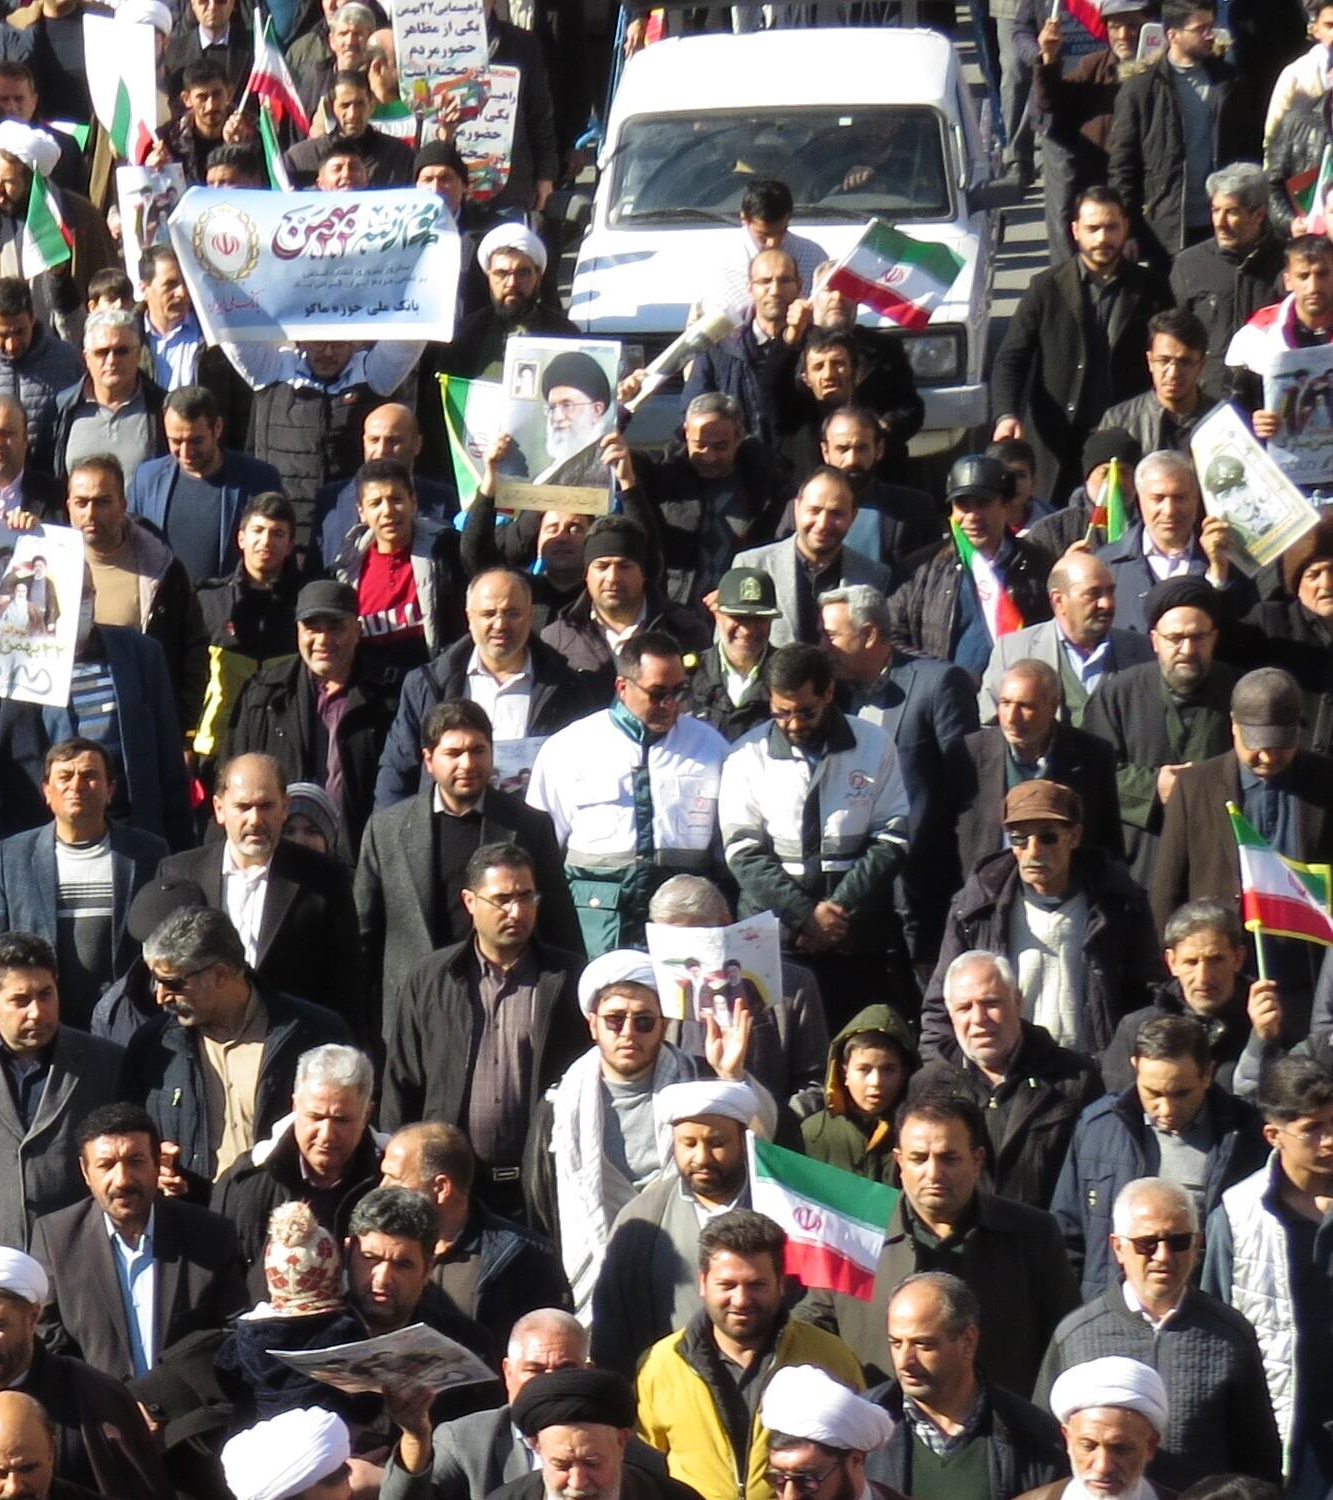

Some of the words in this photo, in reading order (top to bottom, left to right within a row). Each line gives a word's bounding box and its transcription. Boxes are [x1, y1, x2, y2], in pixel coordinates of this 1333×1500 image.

[455, 20, 480, 36] یکی
[367, 300, 389, 317] ملی
[392, 299, 420, 316] بانک
